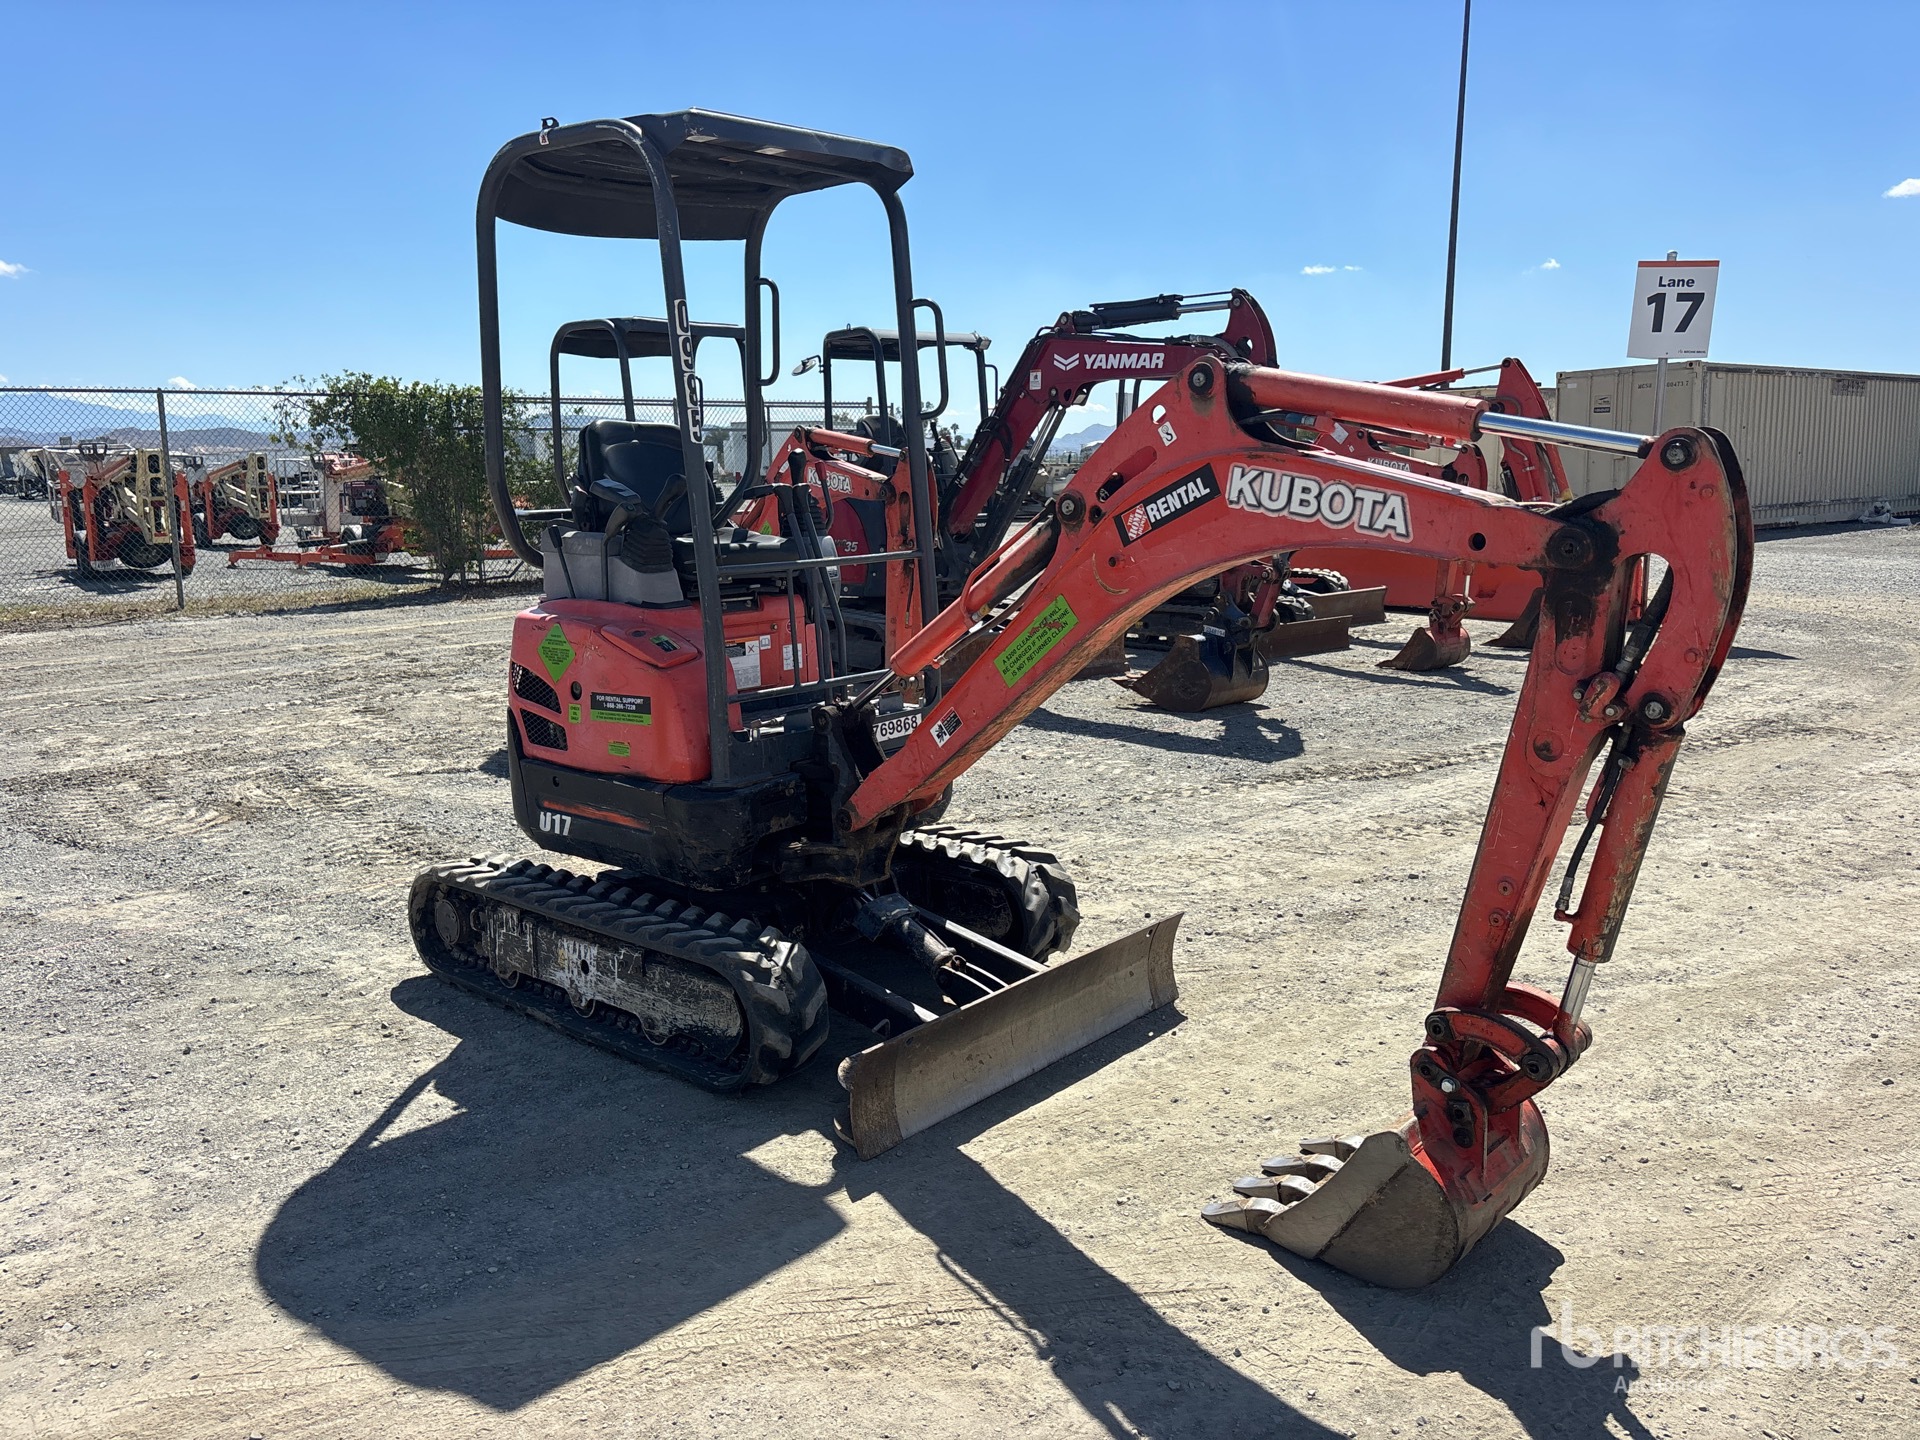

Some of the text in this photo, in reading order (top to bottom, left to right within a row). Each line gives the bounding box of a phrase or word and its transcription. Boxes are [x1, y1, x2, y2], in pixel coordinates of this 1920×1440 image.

[1658, 275, 1695, 288] Lane
[1646, 292, 1706, 333] 17
[1083, 352, 1165, 370] YANMAR
[1145, 477, 1211, 523] RENTAL
[1227, 464, 1411, 539] KUBOTA
[1127, 513, 1135, 526] THE
[1128, 506, 1145, 539] HOME
[1026, 636, 1053, 662] RETURNED
[1036, 630, 1049, 643] THIS
[539, 811, 572, 836] U17
